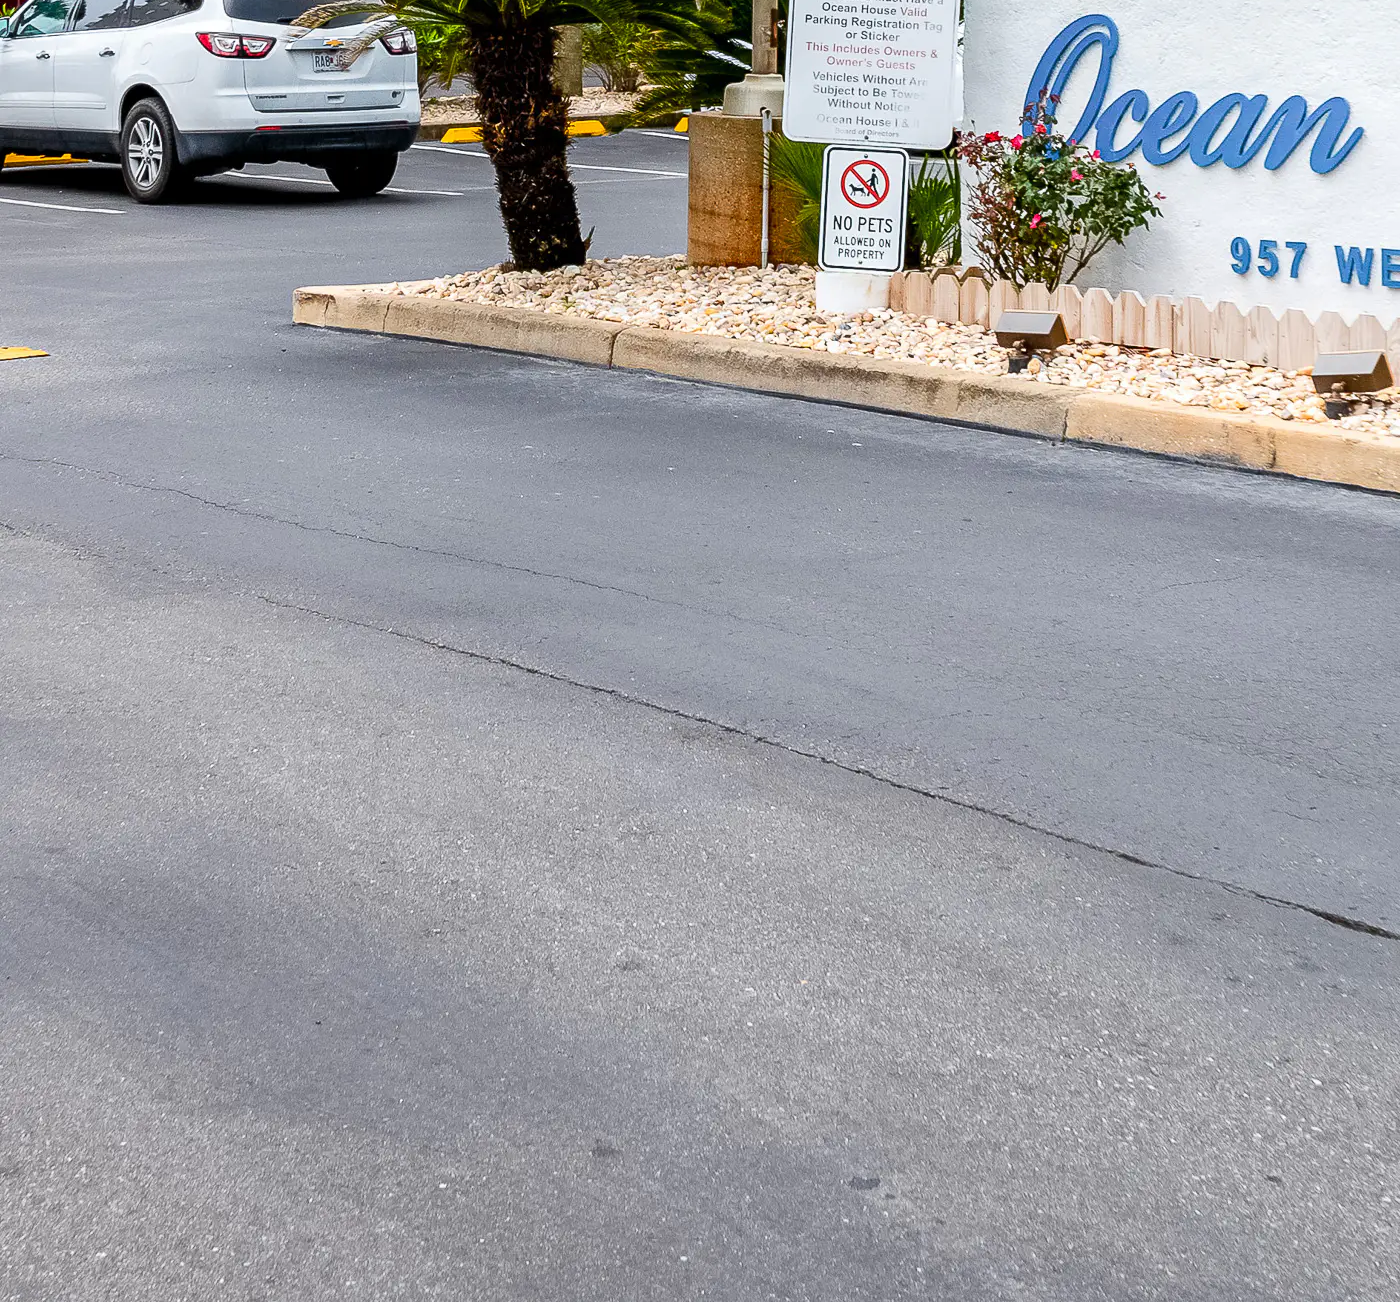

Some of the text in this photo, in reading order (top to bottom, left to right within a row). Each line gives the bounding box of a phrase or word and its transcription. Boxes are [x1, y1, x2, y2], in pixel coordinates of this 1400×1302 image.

[821, 1, 928, 17] Ocean House Valid
[804, 14, 943, 33] Parking Registration Tag
[845, 30, 901, 42] or Sticker
[805, 41, 938, 59] This Includes Owners &
[826, 55, 916, 70] Owner's Guests
[812, 71, 859, 83] Vehicles
[862, 74, 906, 85] Without
[812, 84, 855, 97] Subject
[858, 87, 869, 97] to
[872, 88, 887, 98] Be
[1021, 13, 1364, 174] Ocean
[827, 98, 910, 113] Without Notice
[816, 113, 852, 125] Ocean
[855, 116, 891, 128] House
[867, 129, 900, 138] Directors
[833, 215, 893, 233] NO PETS
[833, 236, 891, 248] ALLOWED ON
[838, 248, 885, 260] PROPERTY
[1230, 236, 1400, 289] 957 WE
